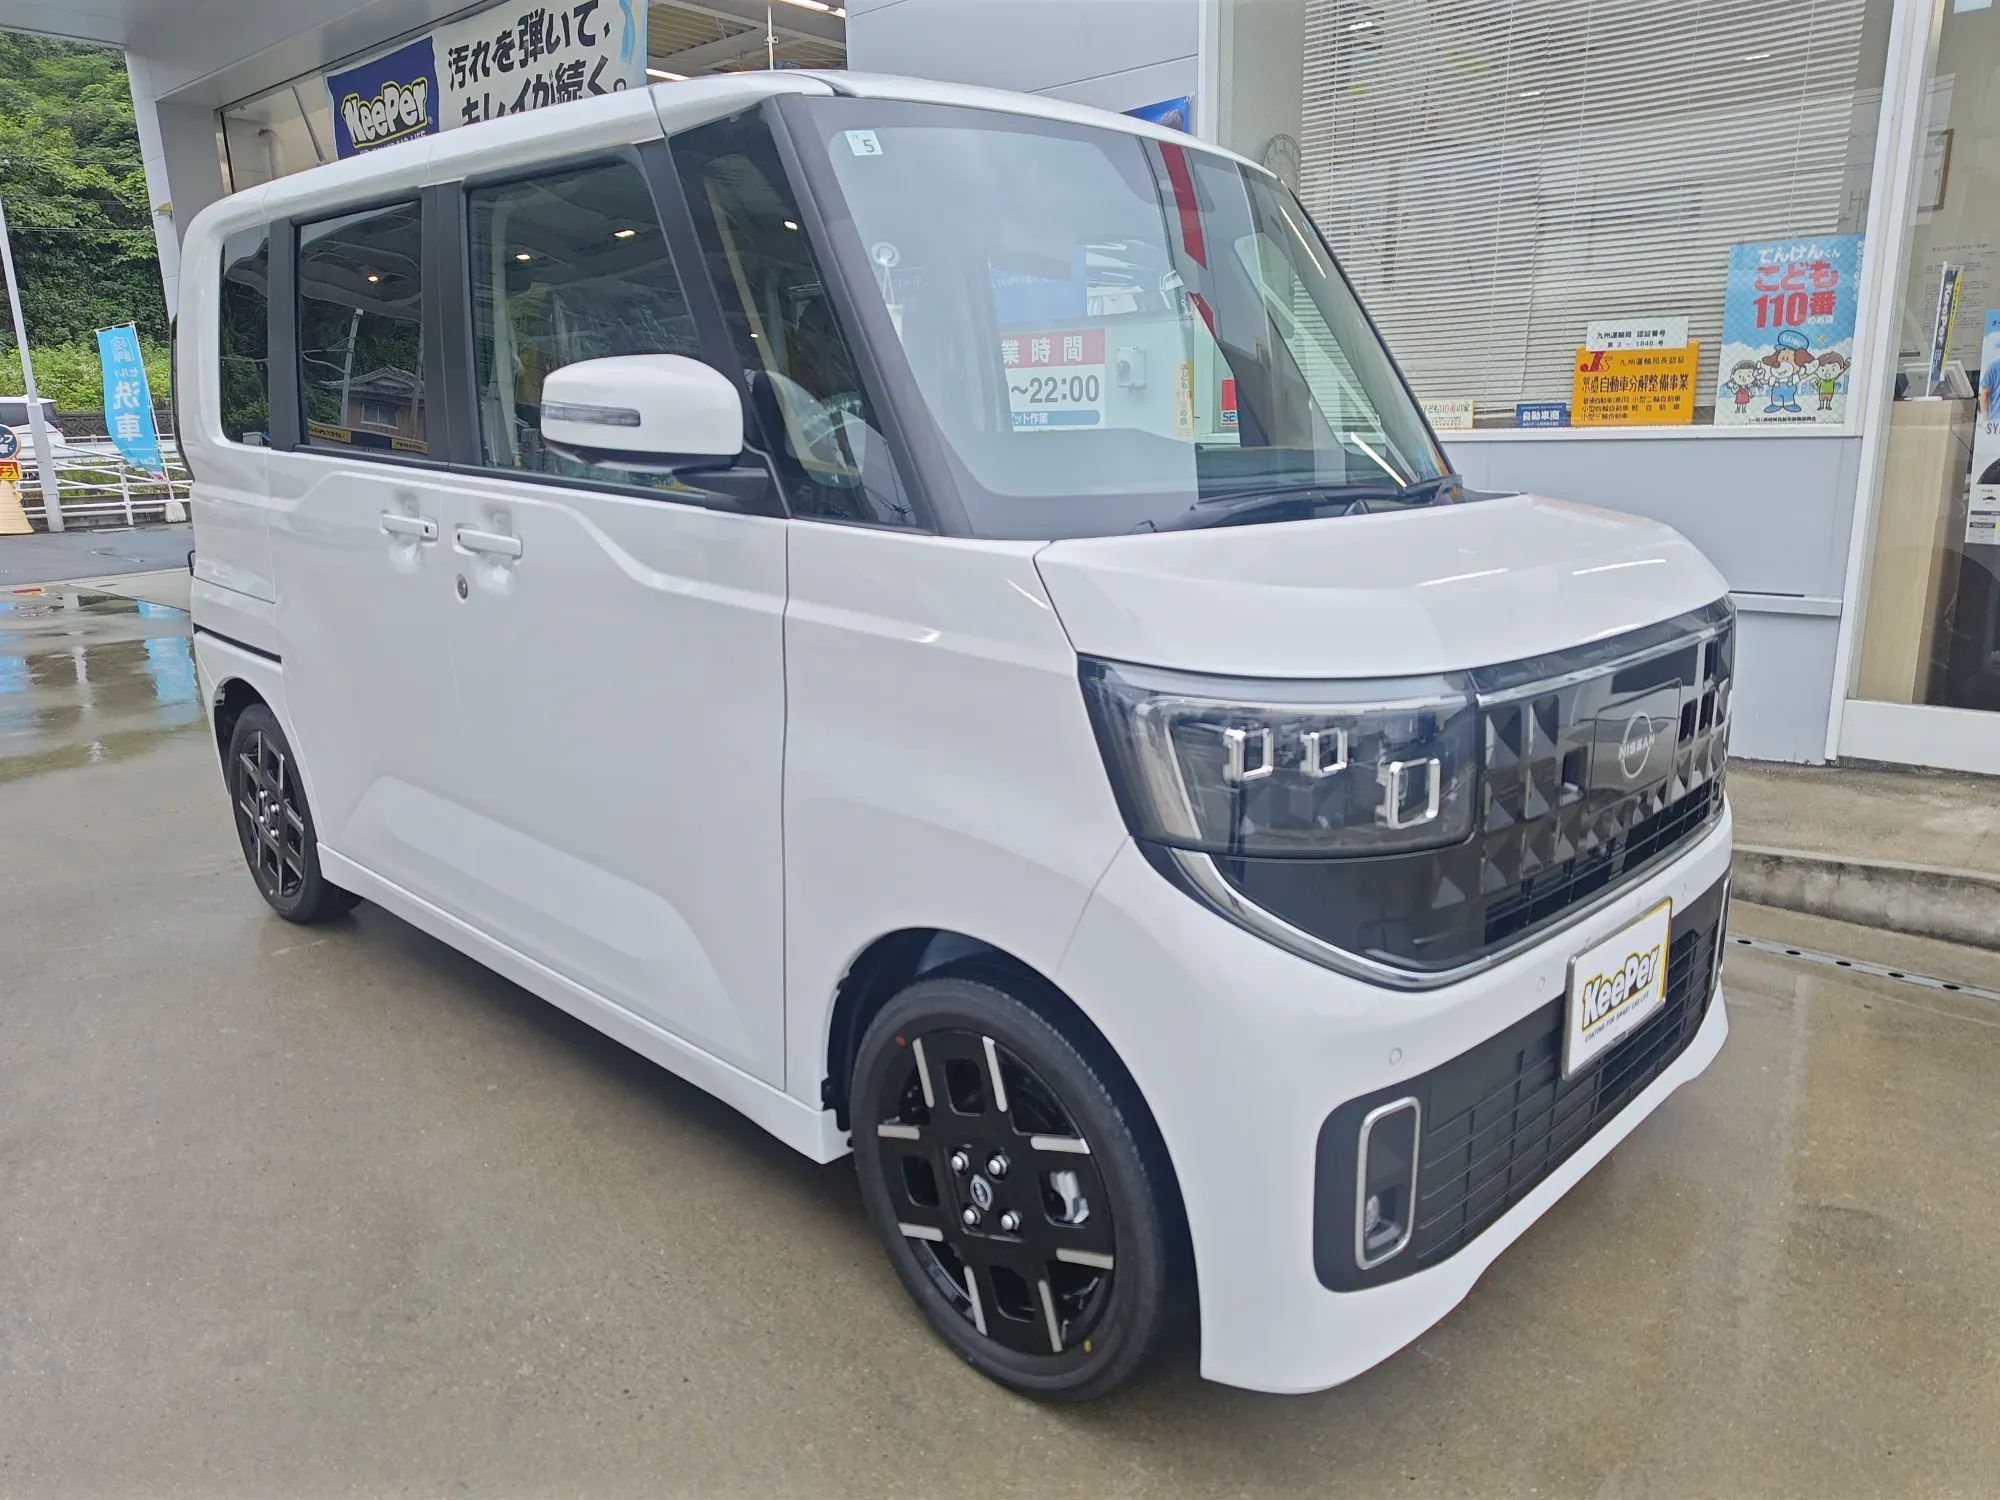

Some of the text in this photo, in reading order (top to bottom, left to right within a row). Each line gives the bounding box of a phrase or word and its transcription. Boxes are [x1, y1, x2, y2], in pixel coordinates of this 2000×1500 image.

[448, 0, 611, 92] 汚れを弾いて、
[862, 139, 875, 153] 5
[1754, 260, 1839, 292] こども
[1753, 290, 1836, 329] 110番
